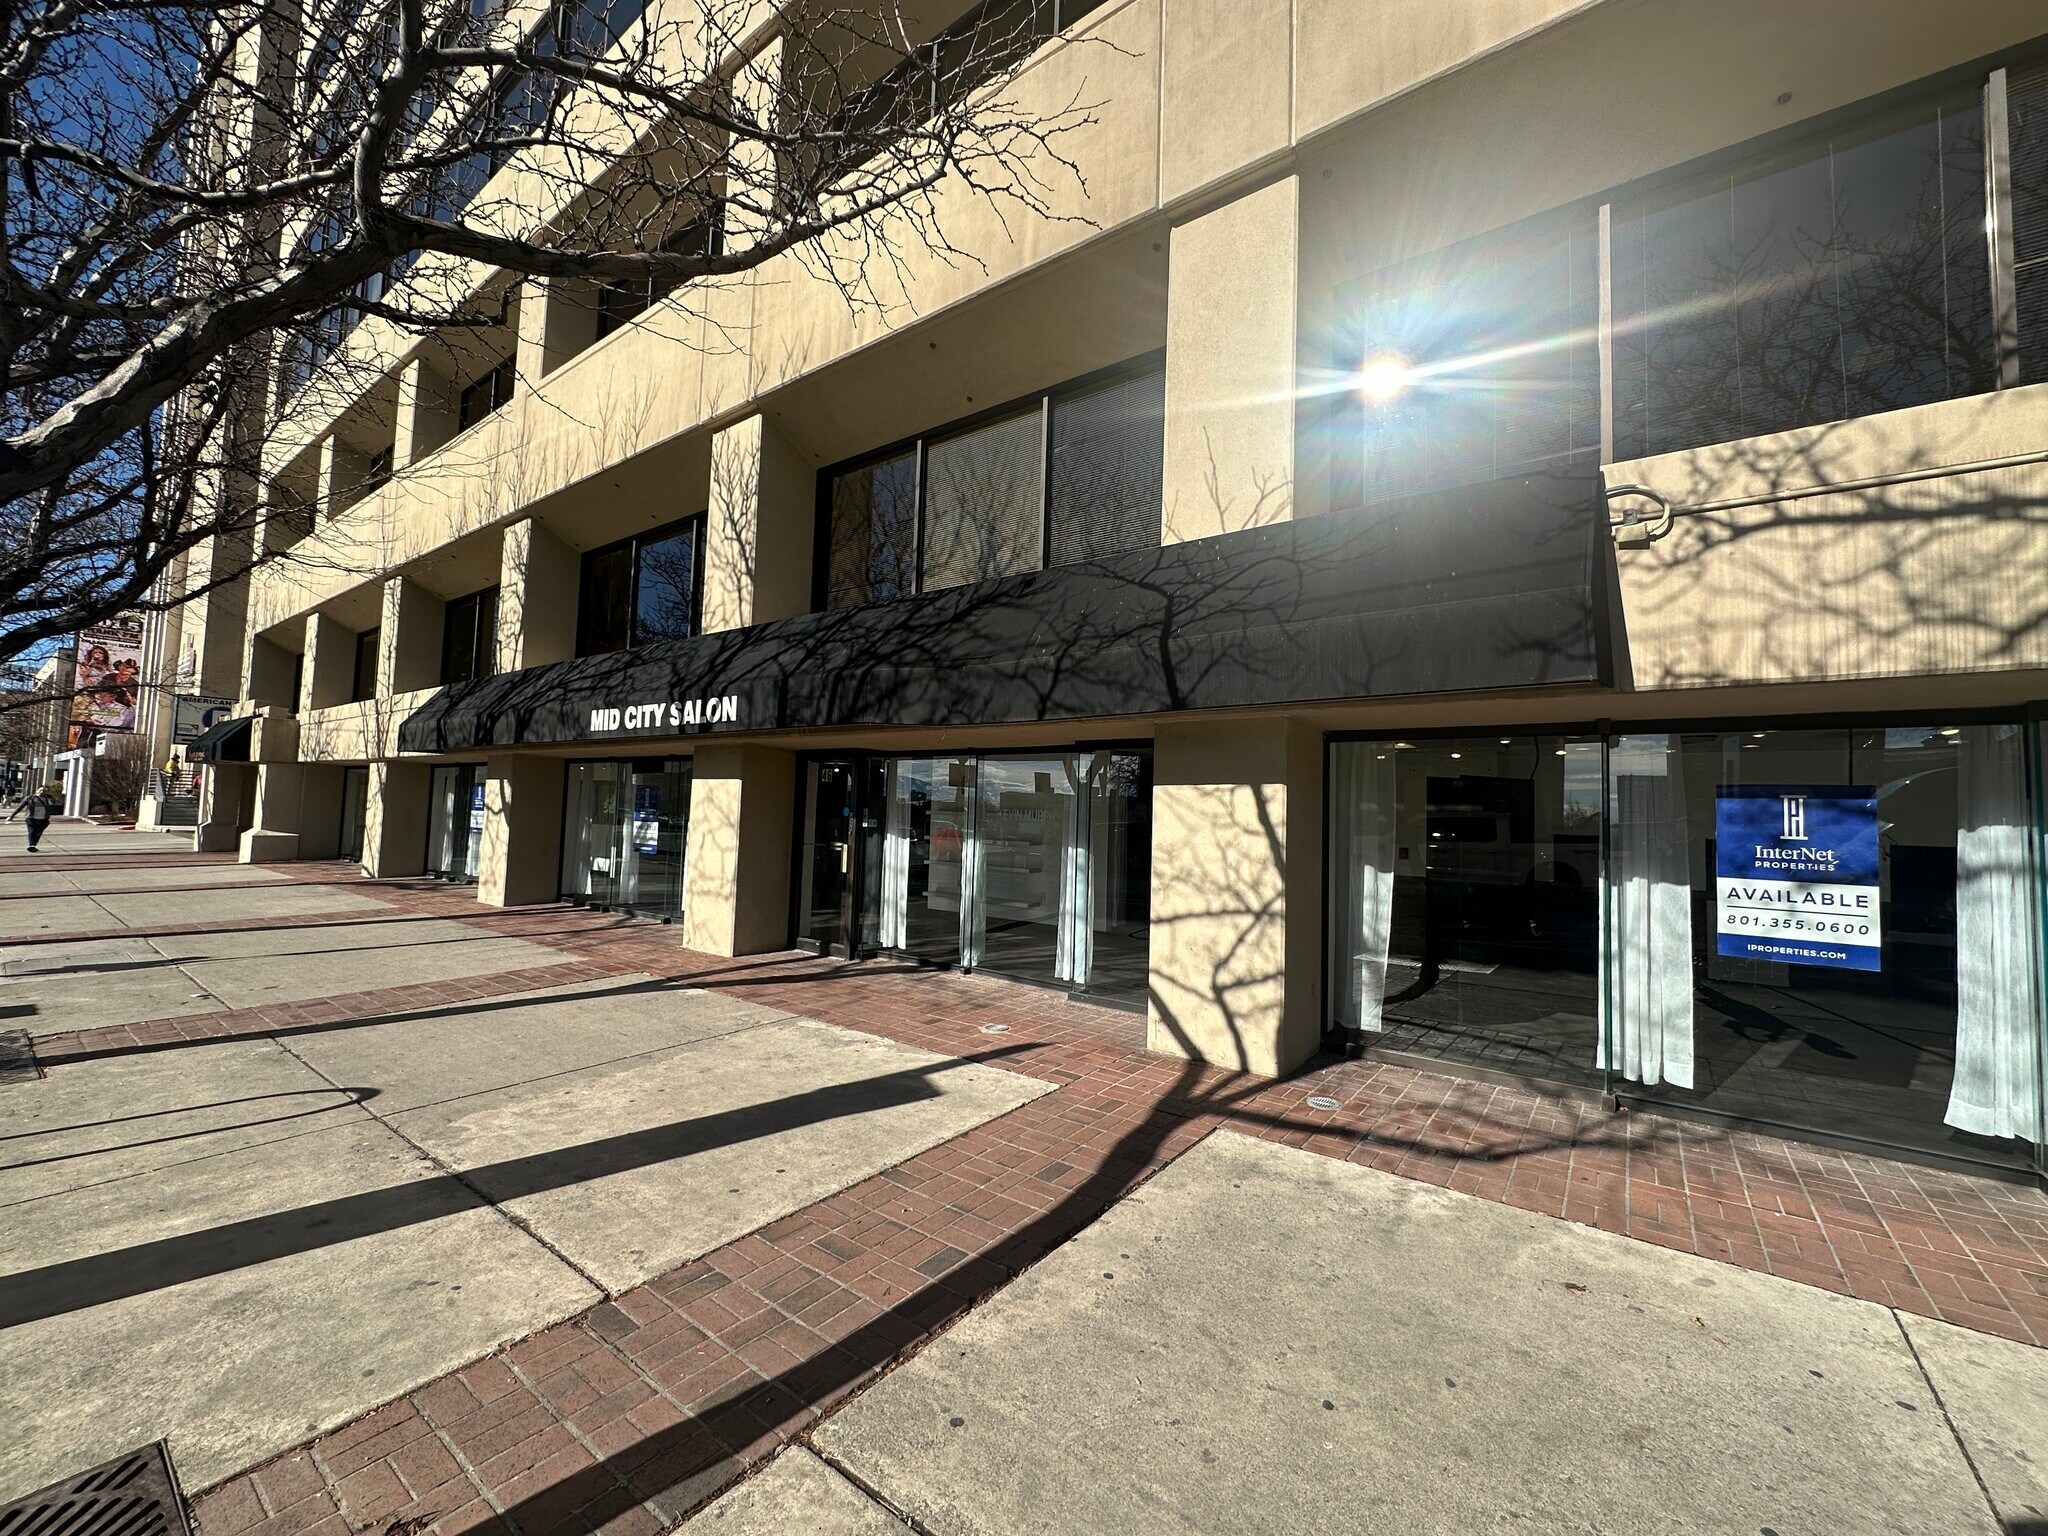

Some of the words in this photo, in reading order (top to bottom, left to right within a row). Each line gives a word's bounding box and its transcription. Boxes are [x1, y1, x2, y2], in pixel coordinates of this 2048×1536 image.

[182, 696, 232, 706] AMERICAN
[590, 708, 621, 732] MID
[624, 702, 667, 730] CITY
[669, 695, 738, 727] SALON
[822, 769, 832, 782] 46
[1755, 845, 1835, 862] InterNet
[1755, 861, 1836, 872] PROPERTIES
[1727, 887, 1869, 909] AVAILABLE
[1727, 914, 1869, 935] 801.355.0600
[1747, 944, 1847, 960] IPROPERTIES.COM
